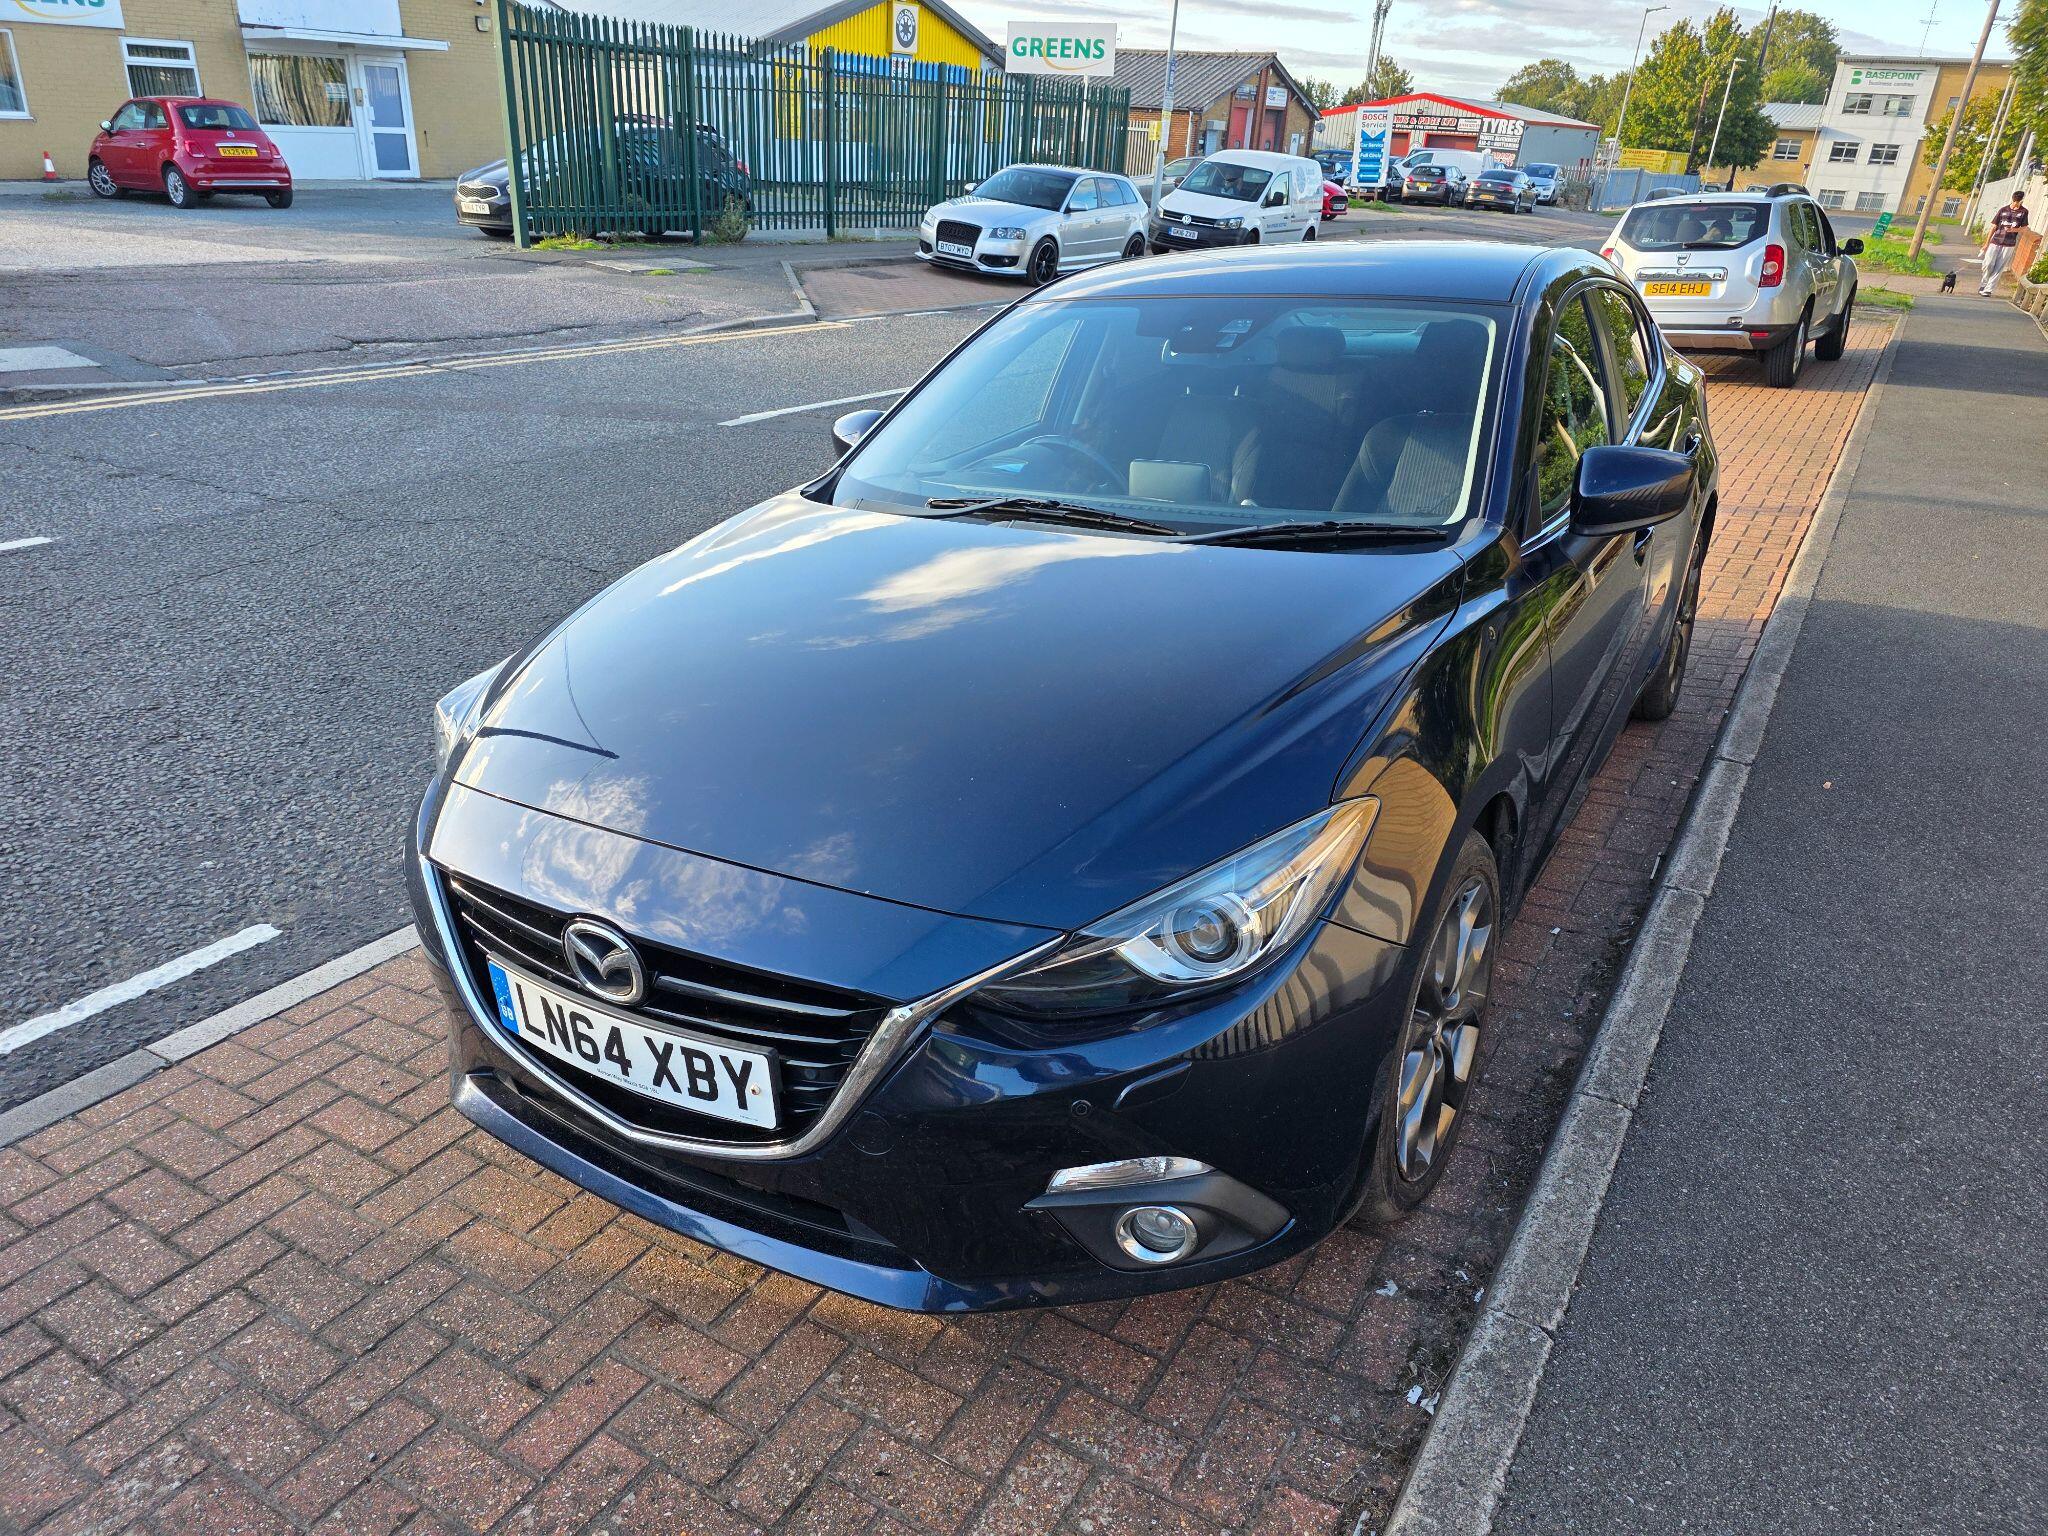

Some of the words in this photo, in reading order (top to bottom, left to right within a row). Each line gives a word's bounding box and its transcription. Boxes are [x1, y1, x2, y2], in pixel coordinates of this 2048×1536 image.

[1012, 36, 1105, 59] GREENS
[1865, 71, 1922, 80] BASEPOINT
[1417, 116, 1441, 126] PAGE
[1482, 117, 1525, 135] TYRES
[1651, 283, 1677, 294] SE14
[1680, 284, 1704, 294] EHJ
[501, 1005, 514, 1021] GB
[515, 981, 633, 1077] LN64
[643, 1035, 753, 1111] XBY
